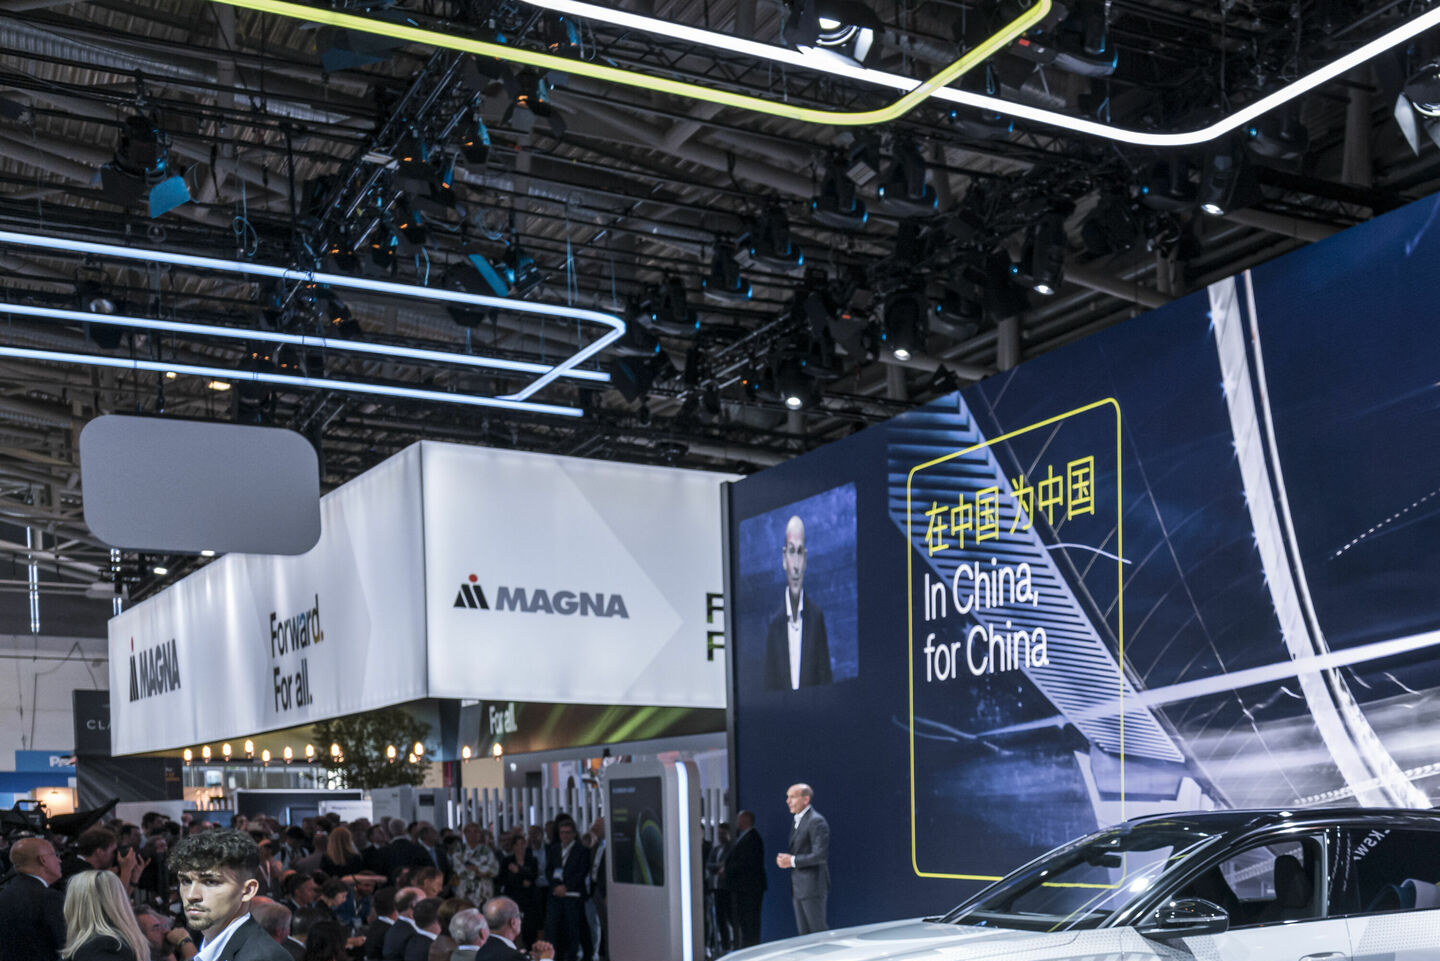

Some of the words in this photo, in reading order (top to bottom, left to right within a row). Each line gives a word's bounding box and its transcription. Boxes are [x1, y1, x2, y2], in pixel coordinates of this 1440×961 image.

[925, 485, 1000, 557] 在中国
[1010, 455, 1095, 535] 为中国
[495, 586, 630, 619] MAGNA
[924, 572, 947, 622] In
[952, 556, 1039, 615] China,
[270, 593, 324, 659] Forward.
[924, 632, 962, 683] for
[966, 619, 1050, 677] China
[139, 638, 181, 700] MAGNA
[273, 666, 293, 713] For
[295, 658, 313, 708] all.
